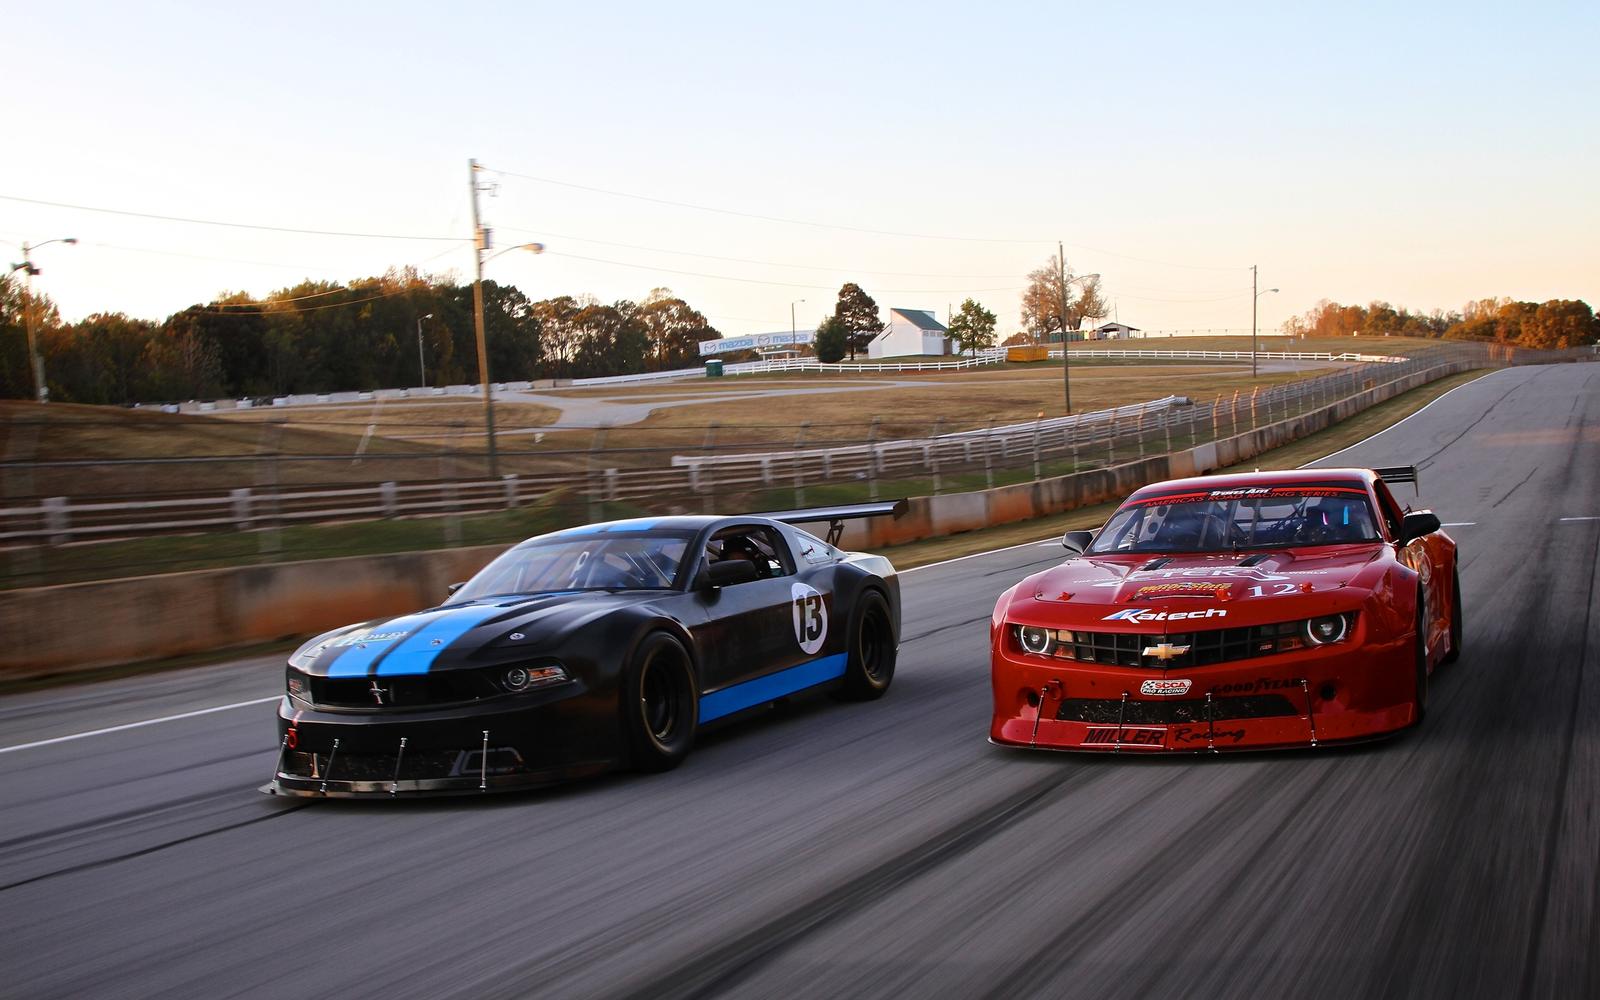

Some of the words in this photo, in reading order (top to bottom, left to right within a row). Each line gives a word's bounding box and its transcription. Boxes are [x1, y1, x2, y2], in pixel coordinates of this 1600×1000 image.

[718, 338, 754, 350] mazda
[1143, 496, 1204, 507] AMERICA'S
[795, 591, 823, 643] 13
[1101, 608, 1227, 624] Katech
[1085, 728, 1166, 745] MILLER
[1175, 727, 1246, 743] Racing
